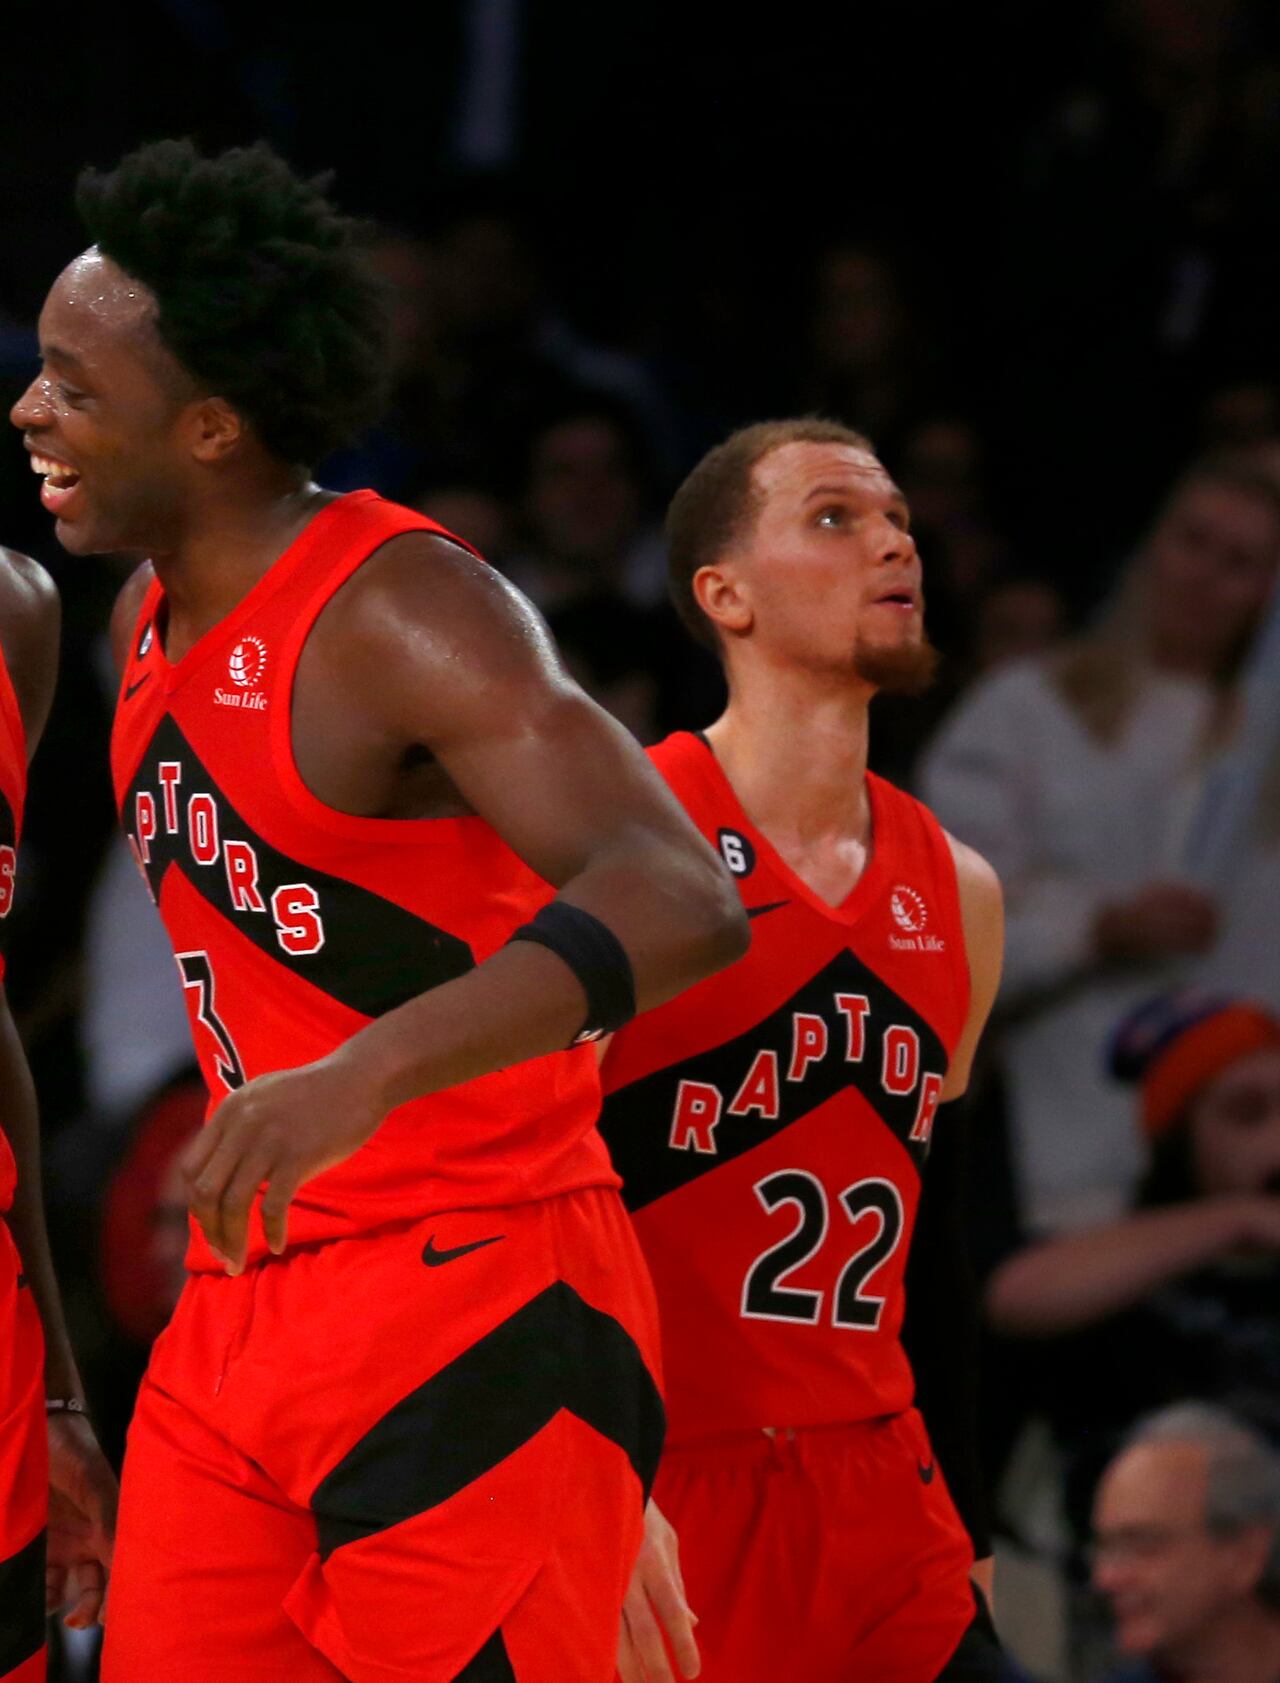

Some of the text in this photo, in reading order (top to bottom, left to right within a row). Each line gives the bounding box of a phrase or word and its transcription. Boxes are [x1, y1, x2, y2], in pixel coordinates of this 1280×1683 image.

[213, 688, 268, 711] Sun Life
[127, 761, 325, 956] PTORS
[721, 834, 747, 873] 6
[887, 934, 916, 951] Sun
[173, 949, 248, 1093] 3
[740, 1167, 905, 1332] 22
